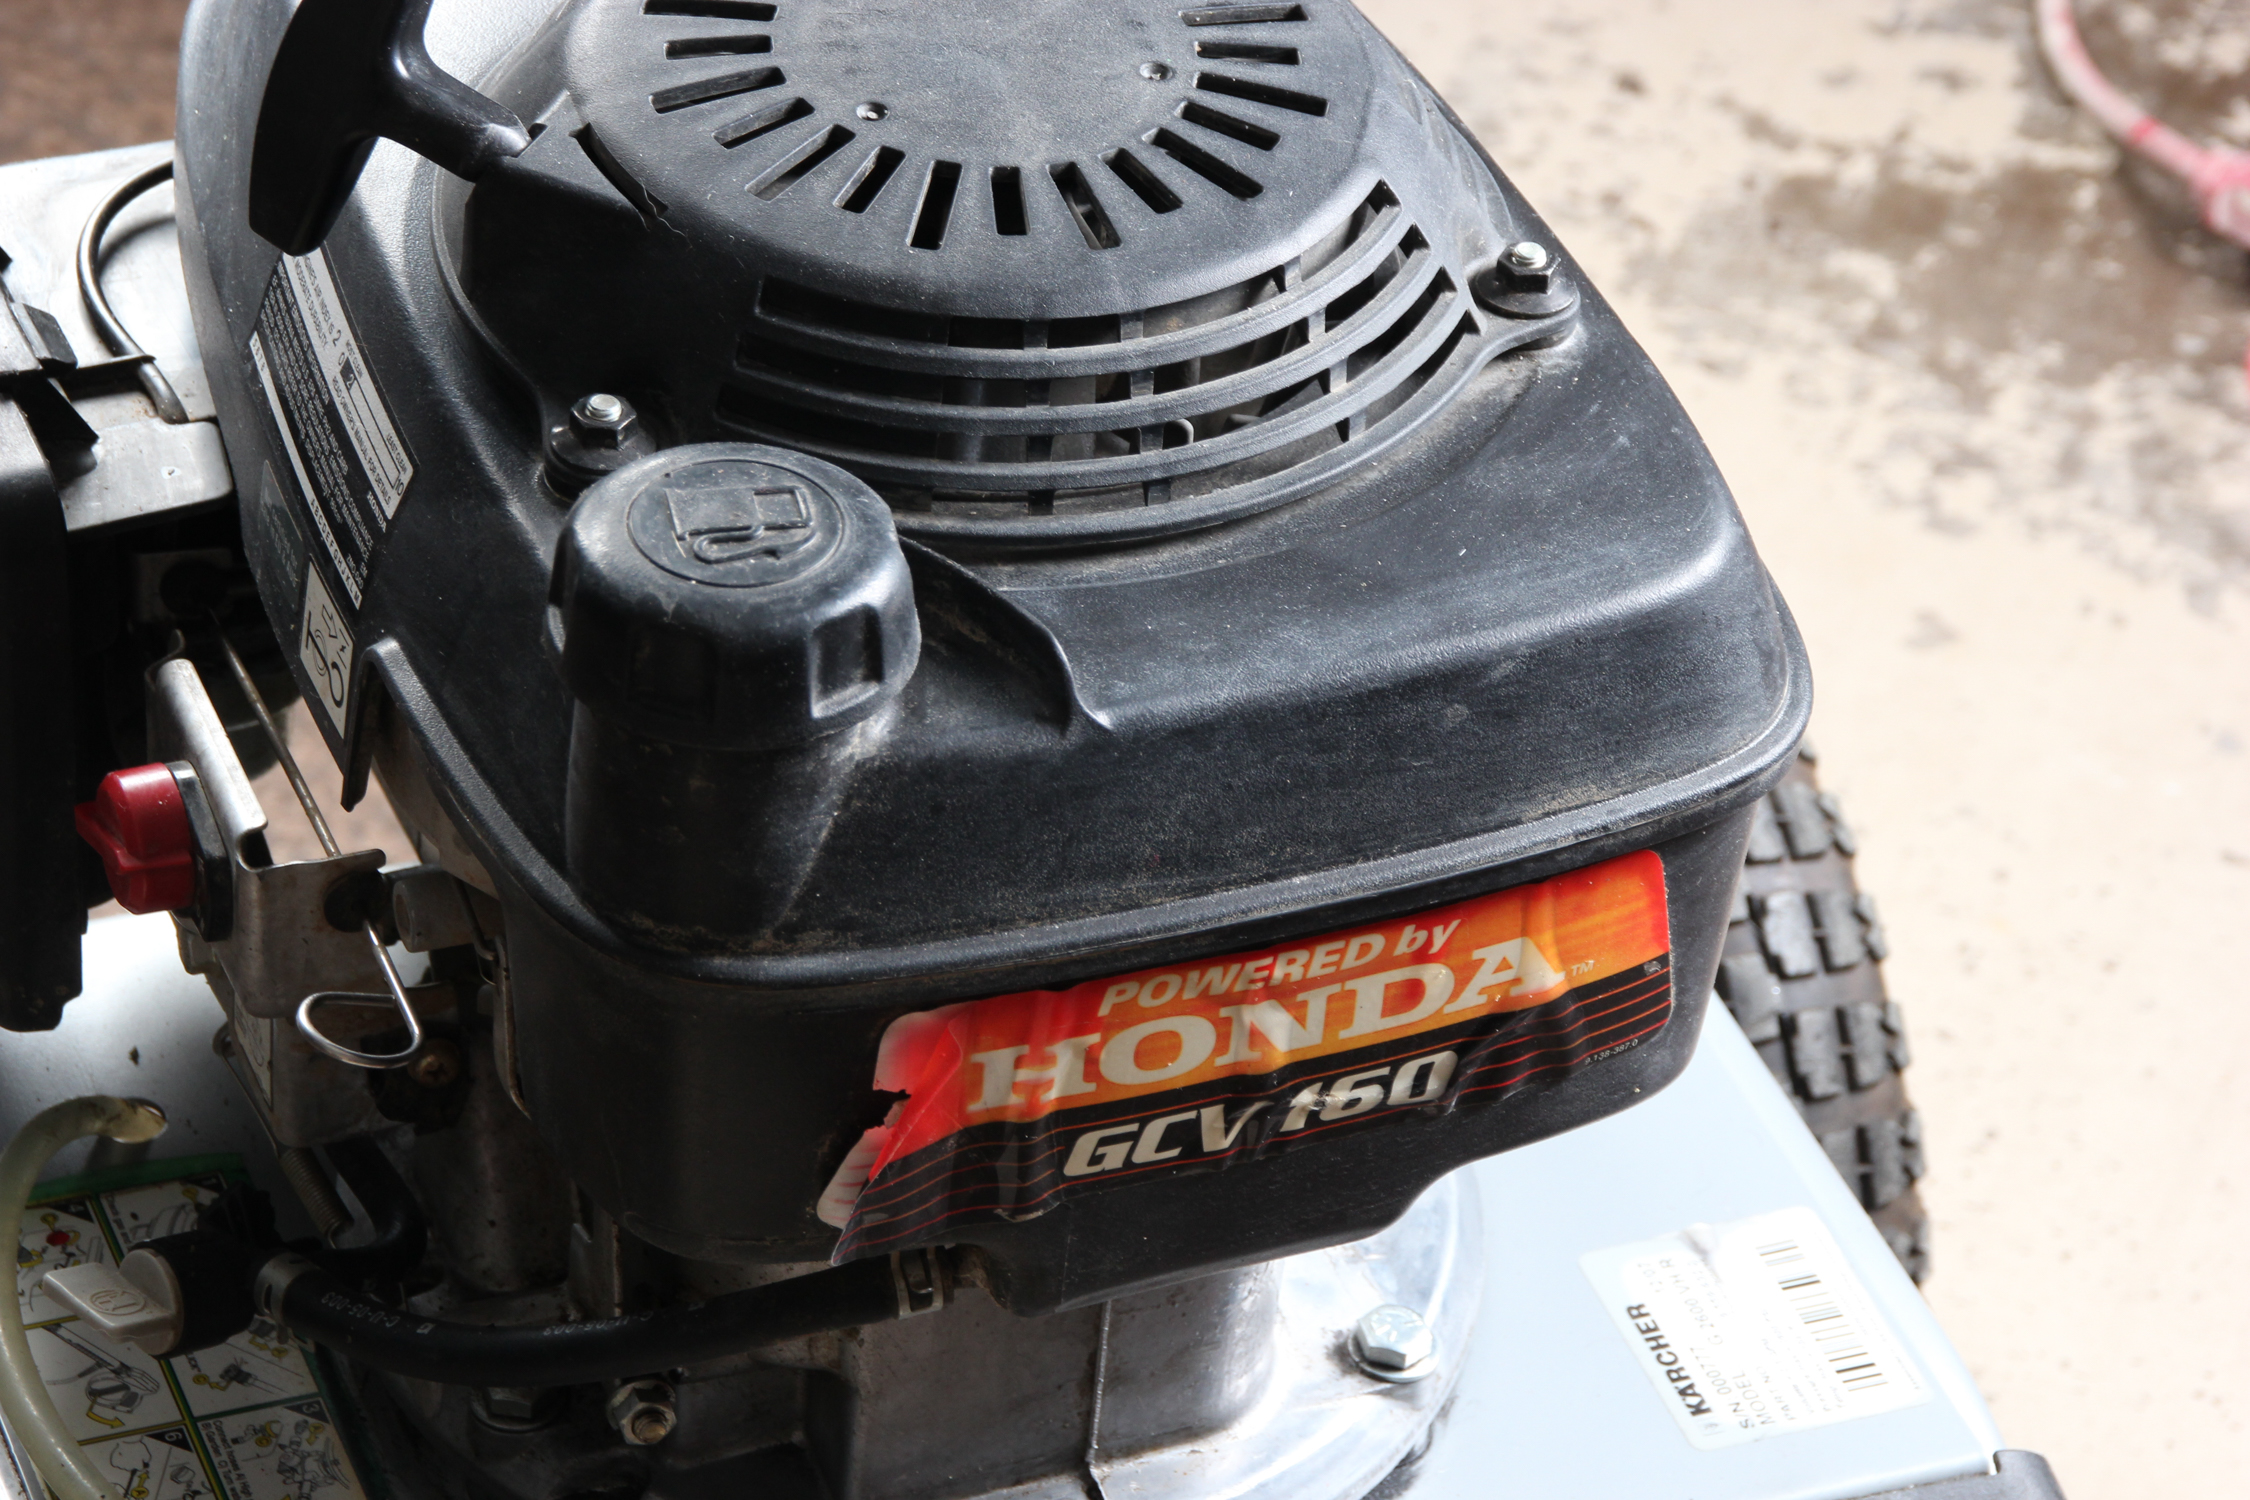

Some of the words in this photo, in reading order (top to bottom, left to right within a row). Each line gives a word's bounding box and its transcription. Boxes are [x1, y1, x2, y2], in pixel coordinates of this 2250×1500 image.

[314, 284, 322, 297] AIR
[320, 299, 330, 323] INDEX
[328, 322, 334, 335] IS
[332, 329, 341, 346] 2
[338, 352, 345, 366] 0
[353, 357, 363, 378] CLEAN
[346, 374, 354, 388] 2
[332, 376, 342, 398] READ
[354, 429, 367, 460] MANUAL
[368, 457, 376, 475] FOR
[329, 434, 338, 452] AND
[337, 450, 348, 474] CARB
[386, 434, 397, 453] LEAST
[396, 452, 407, 474] CLEAN
[329, 455, 349, 499] EMISSIONS
[348, 498, 372, 553] COMPLIANCE
[395, 476, 404, 496] 10
[320, 455, 334, 489] MANUAL
[342, 502, 368, 564] MAINTENANCE
[367, 492, 386, 531] HONDA
[1098, 932, 1386, 1018] POWERED
[1393, 918, 1461, 958] by
[967, 936, 1566, 1114] HONDA
[1584, 1038, 1639, 1066] 9.138-387.0
[1063, 1100, 1274, 1177] GCV
[1279, 1049, 1459, 1133] 160
[1656, 1257, 1676, 1269] R
[1624, 1302, 1712, 1417] KÄRCHER
[1705, 1333, 1725, 1346] G
[302, 1403, 320, 1414] 3
[1728, 1369, 1776, 1425] MODEL
[164, 1431, 183, 1442] 6
[213, 1420, 232, 1449] Connect
[226, 1449, 241, 1472] hoses
[205, 1430, 222, 1458] Garden
[222, 1468, 234, 1485] Turn
